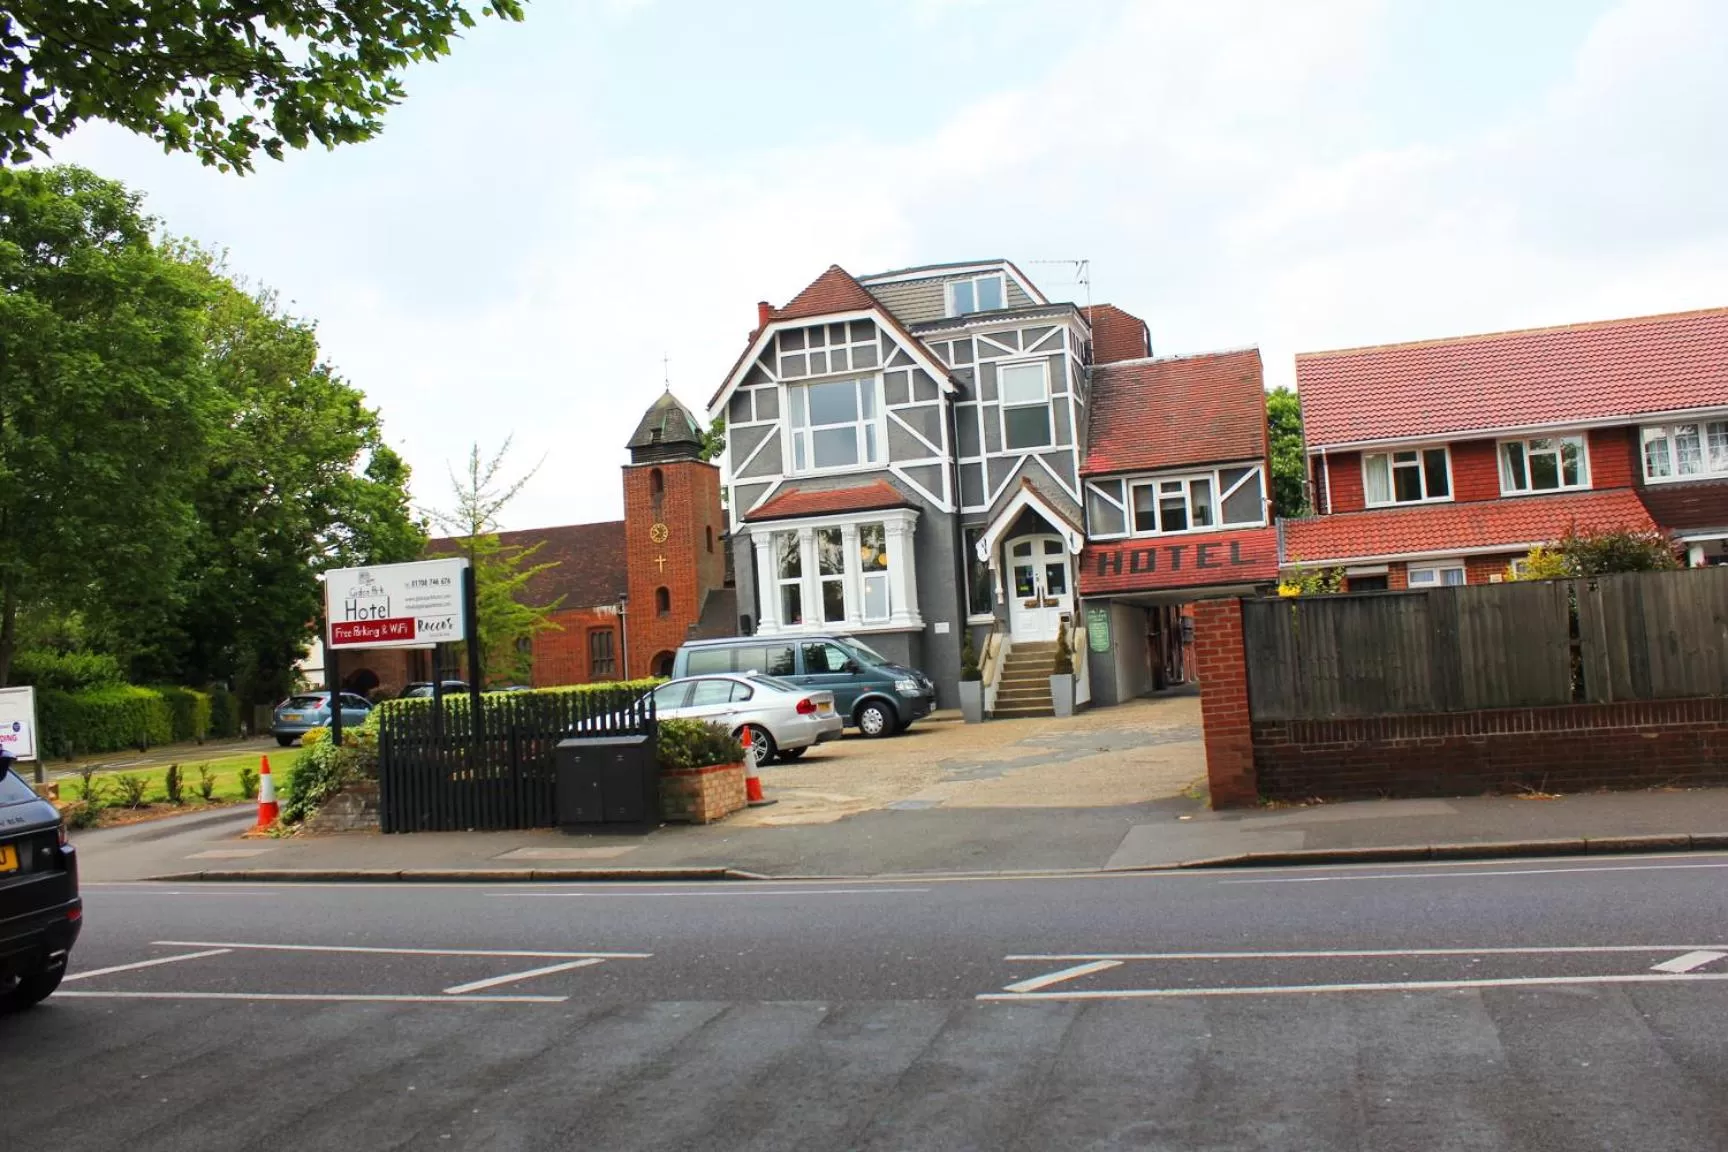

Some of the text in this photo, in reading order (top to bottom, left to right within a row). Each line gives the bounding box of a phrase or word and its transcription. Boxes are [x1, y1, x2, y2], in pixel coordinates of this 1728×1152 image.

[1097, 541, 1256, 576] HOTEL
[345, 596, 390, 621] Hotel
[335, 627, 352, 638] Free
[353, 624, 380, 638] Parking
